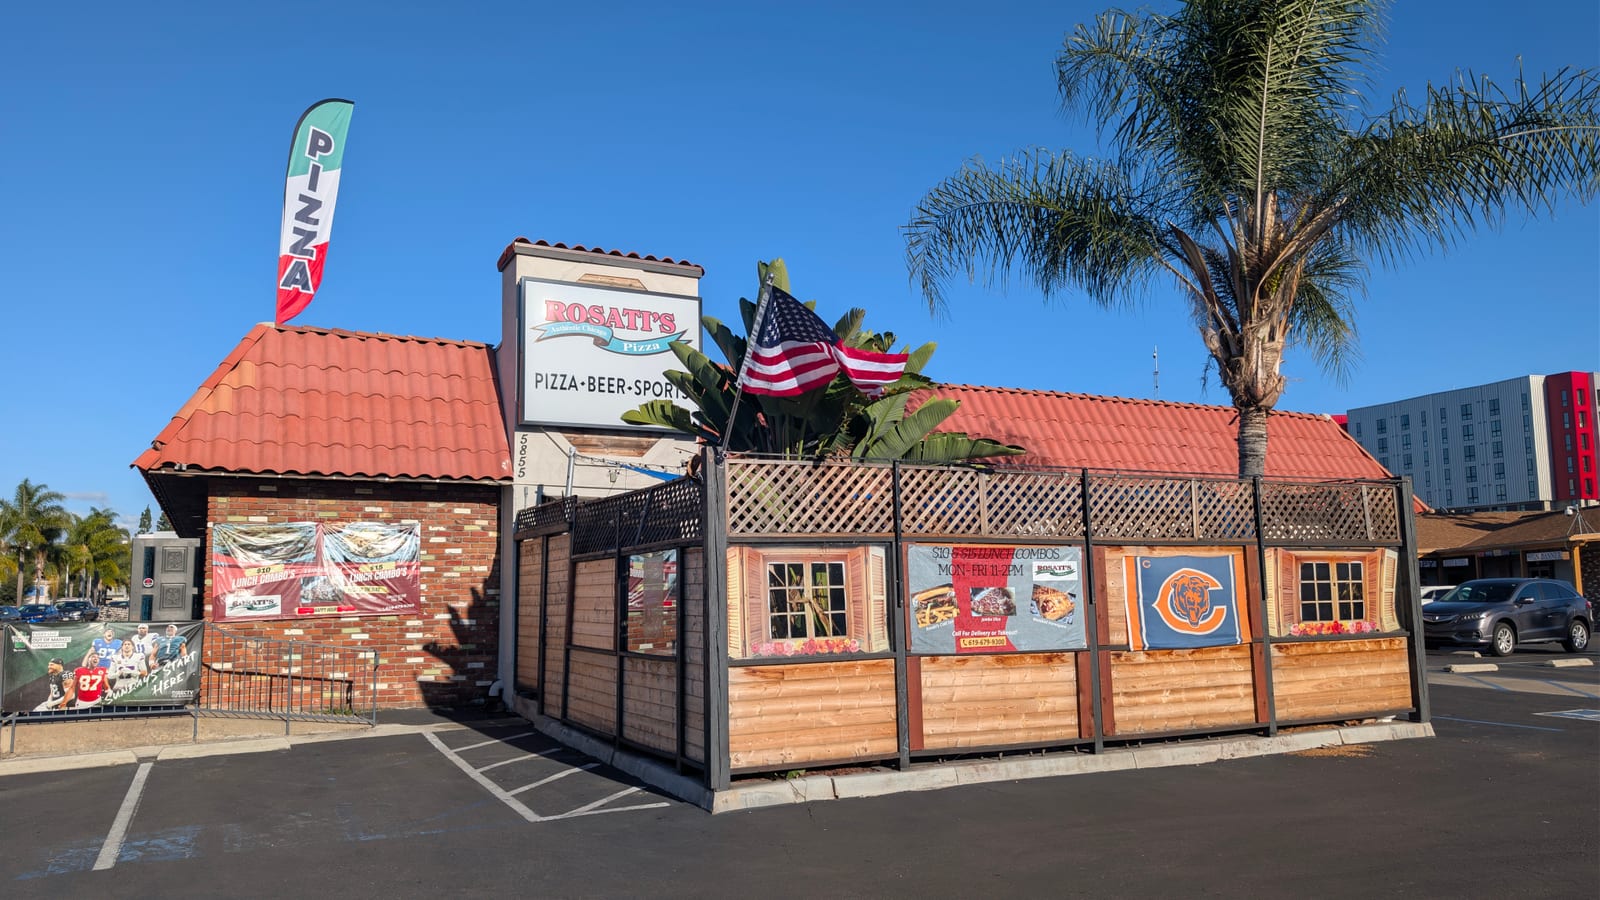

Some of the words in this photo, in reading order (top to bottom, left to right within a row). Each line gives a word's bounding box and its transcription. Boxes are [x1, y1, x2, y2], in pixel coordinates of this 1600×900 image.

[279, 125, 334, 294] PIZZA
[544, 299, 676, 334] ROSATI'S
[623, 341, 660, 351] Pizza
[535, 372, 578, 392] PIZZA
[587, 376, 626, 395] BEER
[518, 433, 528, 478] 5855
[932, 547, 950, 559] $10
[961, 547, 977, 559] $15
[977, 547, 1015, 559] LUNCH
[1015, 548, 1060, 560] COMBOS
[231, 575, 258, 588] LUNCH
[260, 569, 296, 585] COMBO'S
[374, 567, 408, 580] COMBO'S
[990, 564, 1024, 577] 11-2PM
[163, 651, 197, 676] START
[79, 675, 102, 691] 87
[152, 672, 185, 696] HERE
